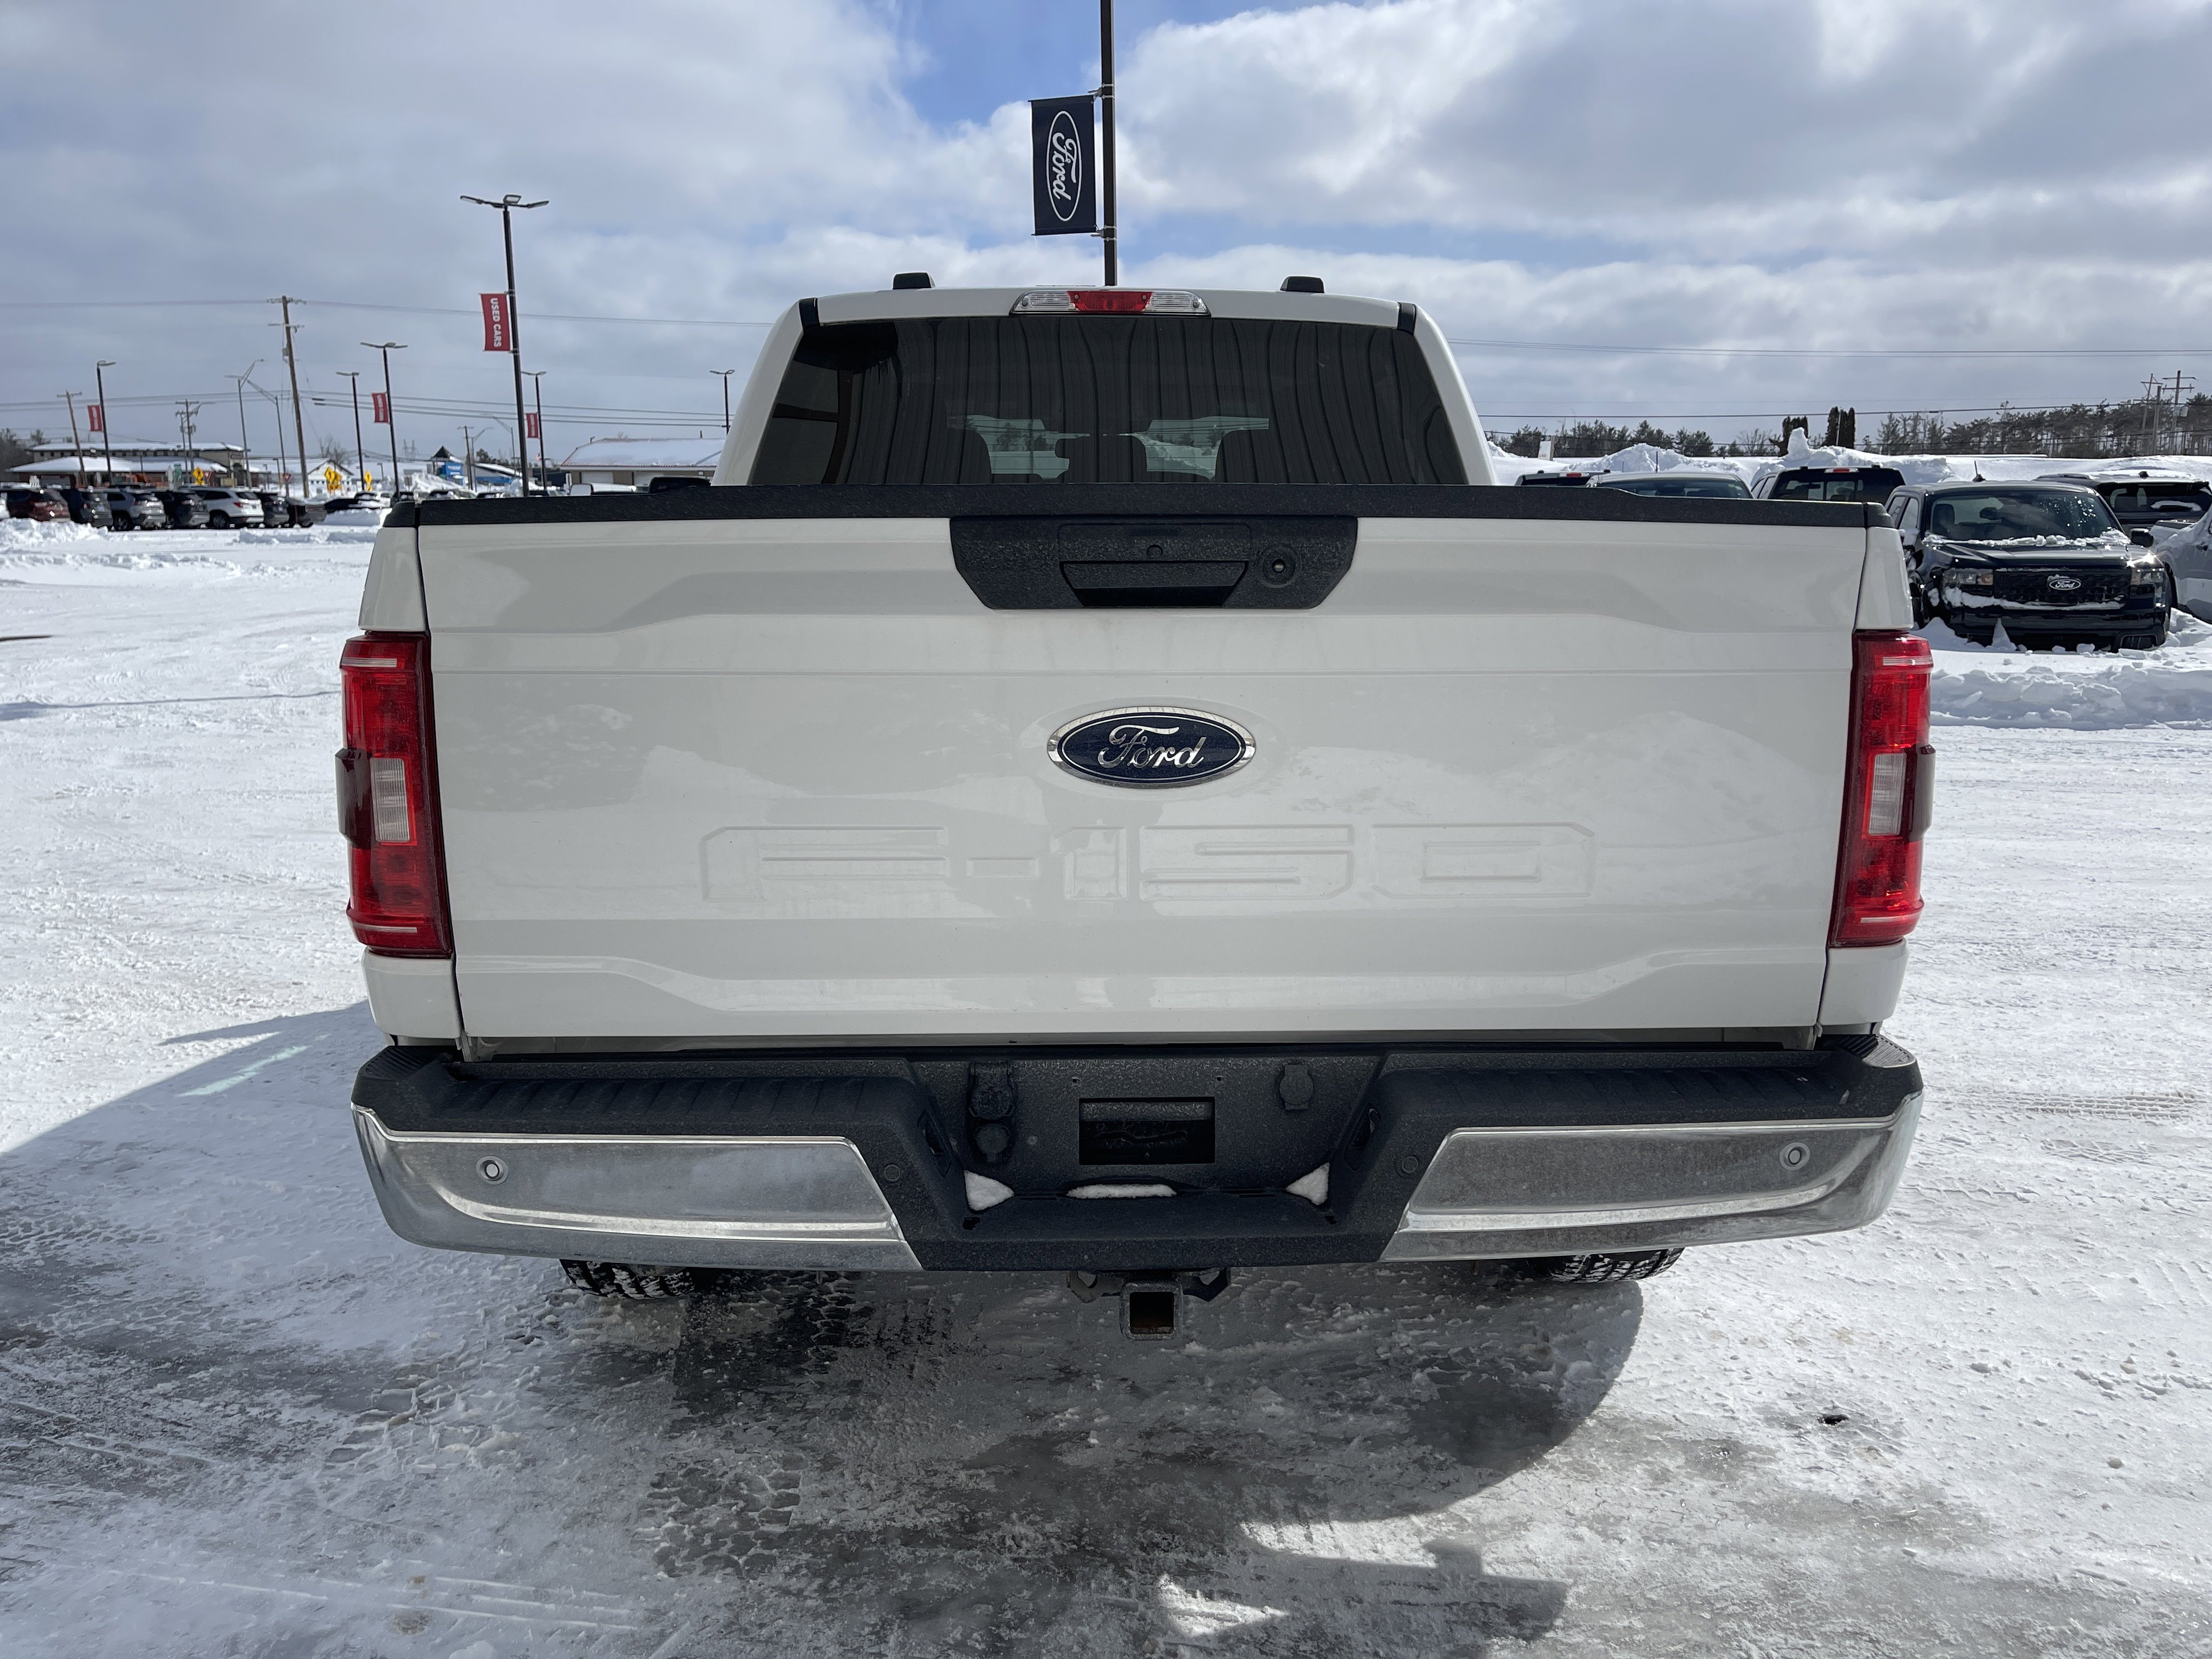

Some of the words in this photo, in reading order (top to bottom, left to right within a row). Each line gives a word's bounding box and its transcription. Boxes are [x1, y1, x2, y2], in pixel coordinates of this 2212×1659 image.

[1052, 132, 1077, 201] Ford
[490, 297, 500, 322] USED
[493, 323, 501, 348] CARS
[1098, 724, 1207, 769] Ford
[699, 822, 1595, 902] F-150
